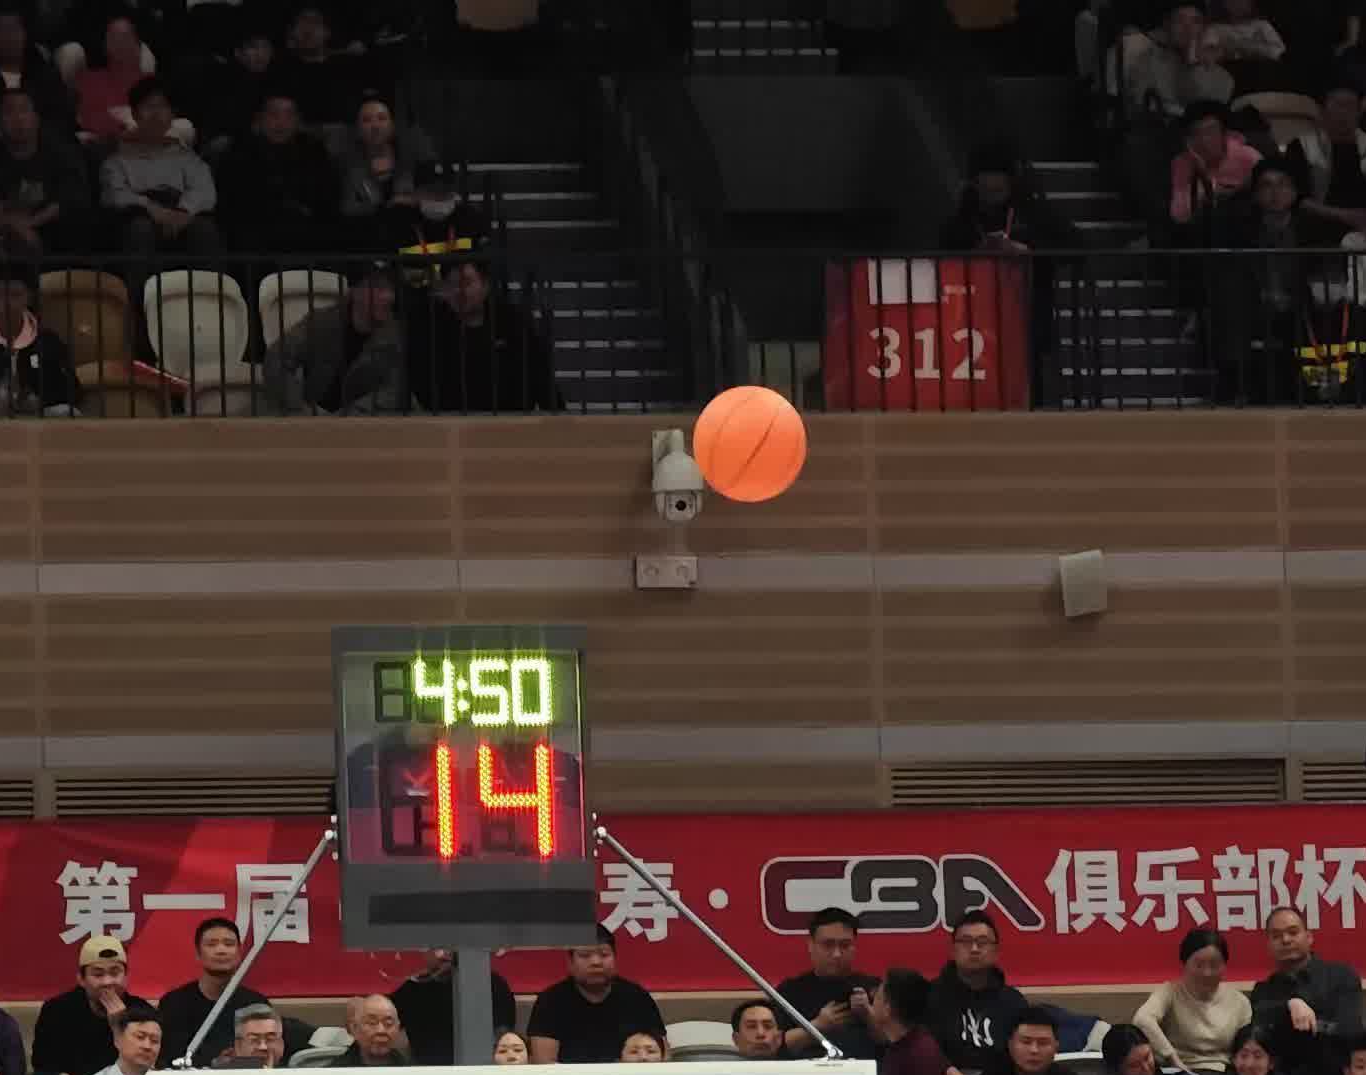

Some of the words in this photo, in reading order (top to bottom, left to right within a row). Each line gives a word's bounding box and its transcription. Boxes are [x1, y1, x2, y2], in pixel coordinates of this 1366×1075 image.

[867, 326, 988, 381] 312
[413, 657, 553, 726] 4:50
[435, 743, 555, 858] 14
